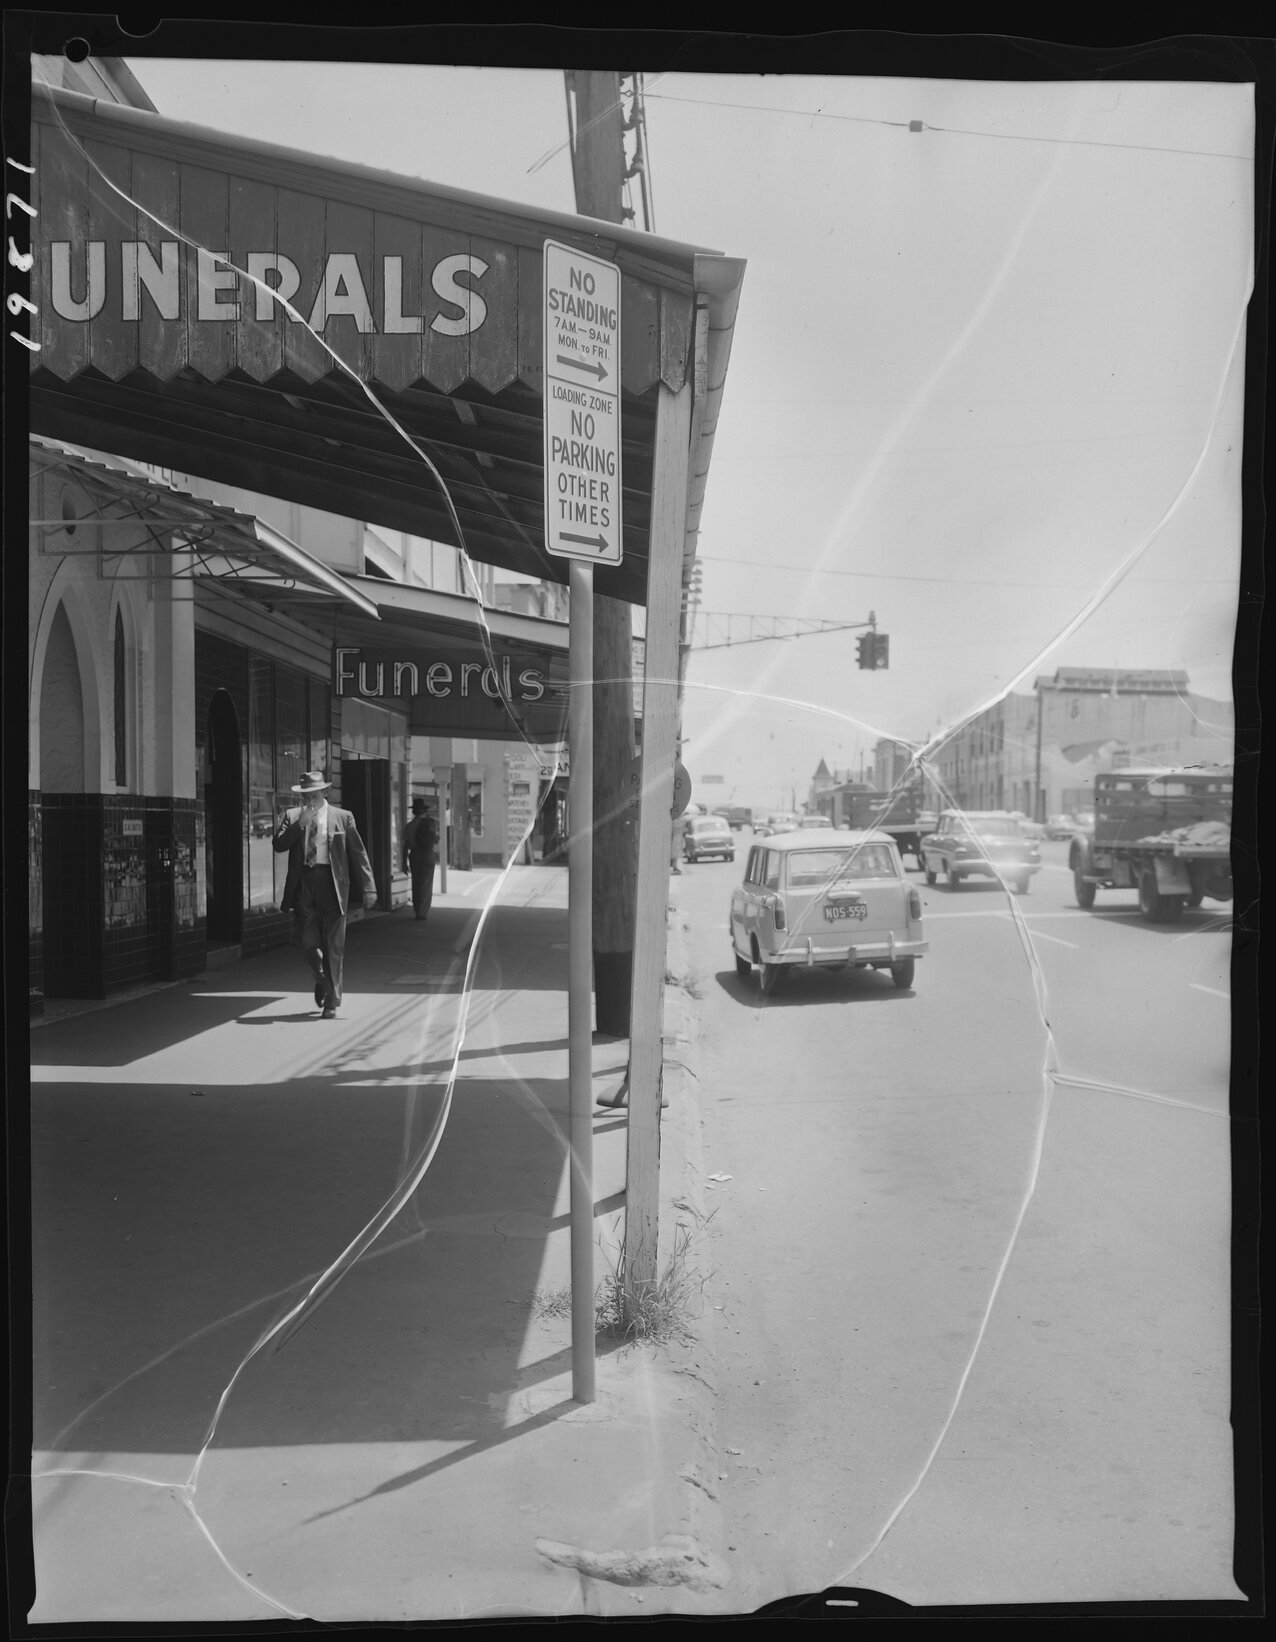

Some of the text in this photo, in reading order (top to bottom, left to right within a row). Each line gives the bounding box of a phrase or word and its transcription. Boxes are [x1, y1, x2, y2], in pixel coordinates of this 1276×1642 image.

[31, 239, 491, 337] UNERALS
[570, 266, 596, 296] NO
[548, 287, 617, 331] STANDING
[558, 333, 580, 350] MON.
[592, 345, 610, 360] FRI.
[552, 385, 613, 415] LOADING ZONE
[571, 409, 595, 441] NO
[552, 435, 616, 477] PARKING
[557, 472, 610, 503] OTHER
[558, 498, 610, 528] TIMES
[336, 648, 545, 702] Funerals
